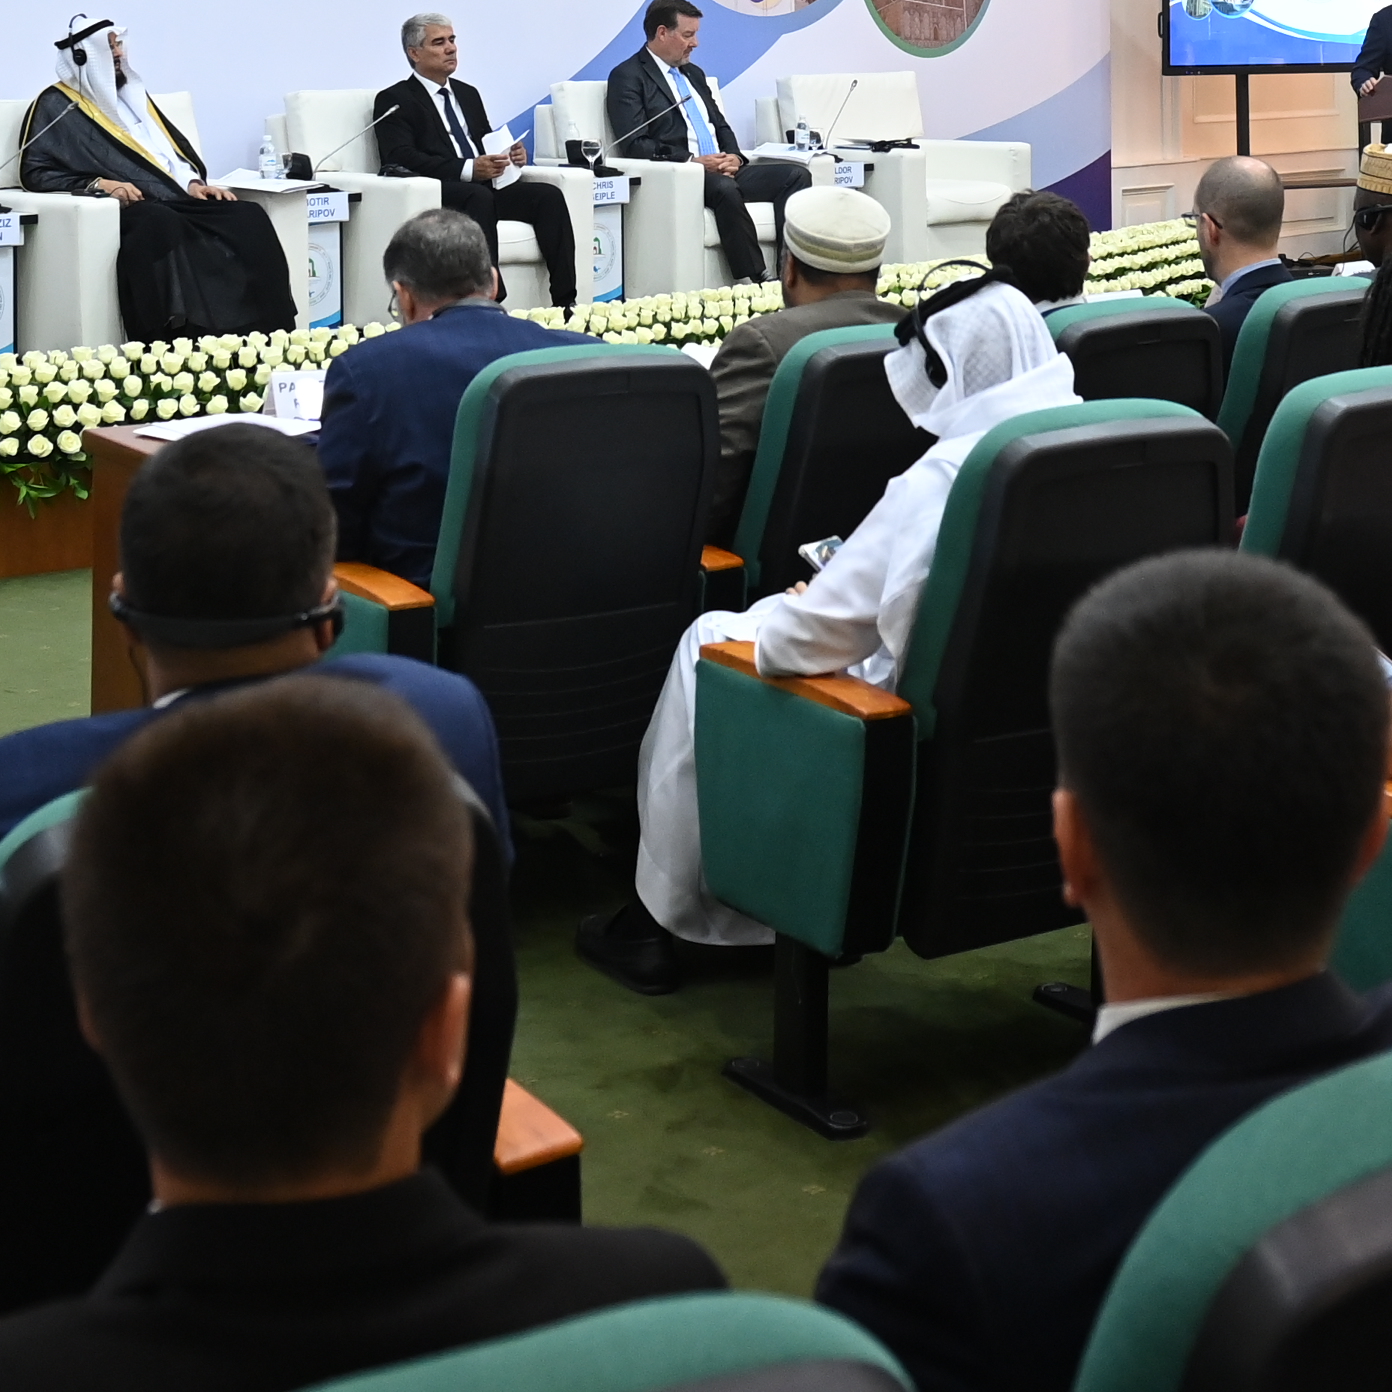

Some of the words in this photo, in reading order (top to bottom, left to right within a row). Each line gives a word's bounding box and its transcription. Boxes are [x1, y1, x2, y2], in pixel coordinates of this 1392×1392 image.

[835, 166, 852, 174] LDOR
[834, 176, 853, 184] RIPOV
[593, 191, 615, 201] EIPLE
[308, 209, 335, 218] RIPOV
